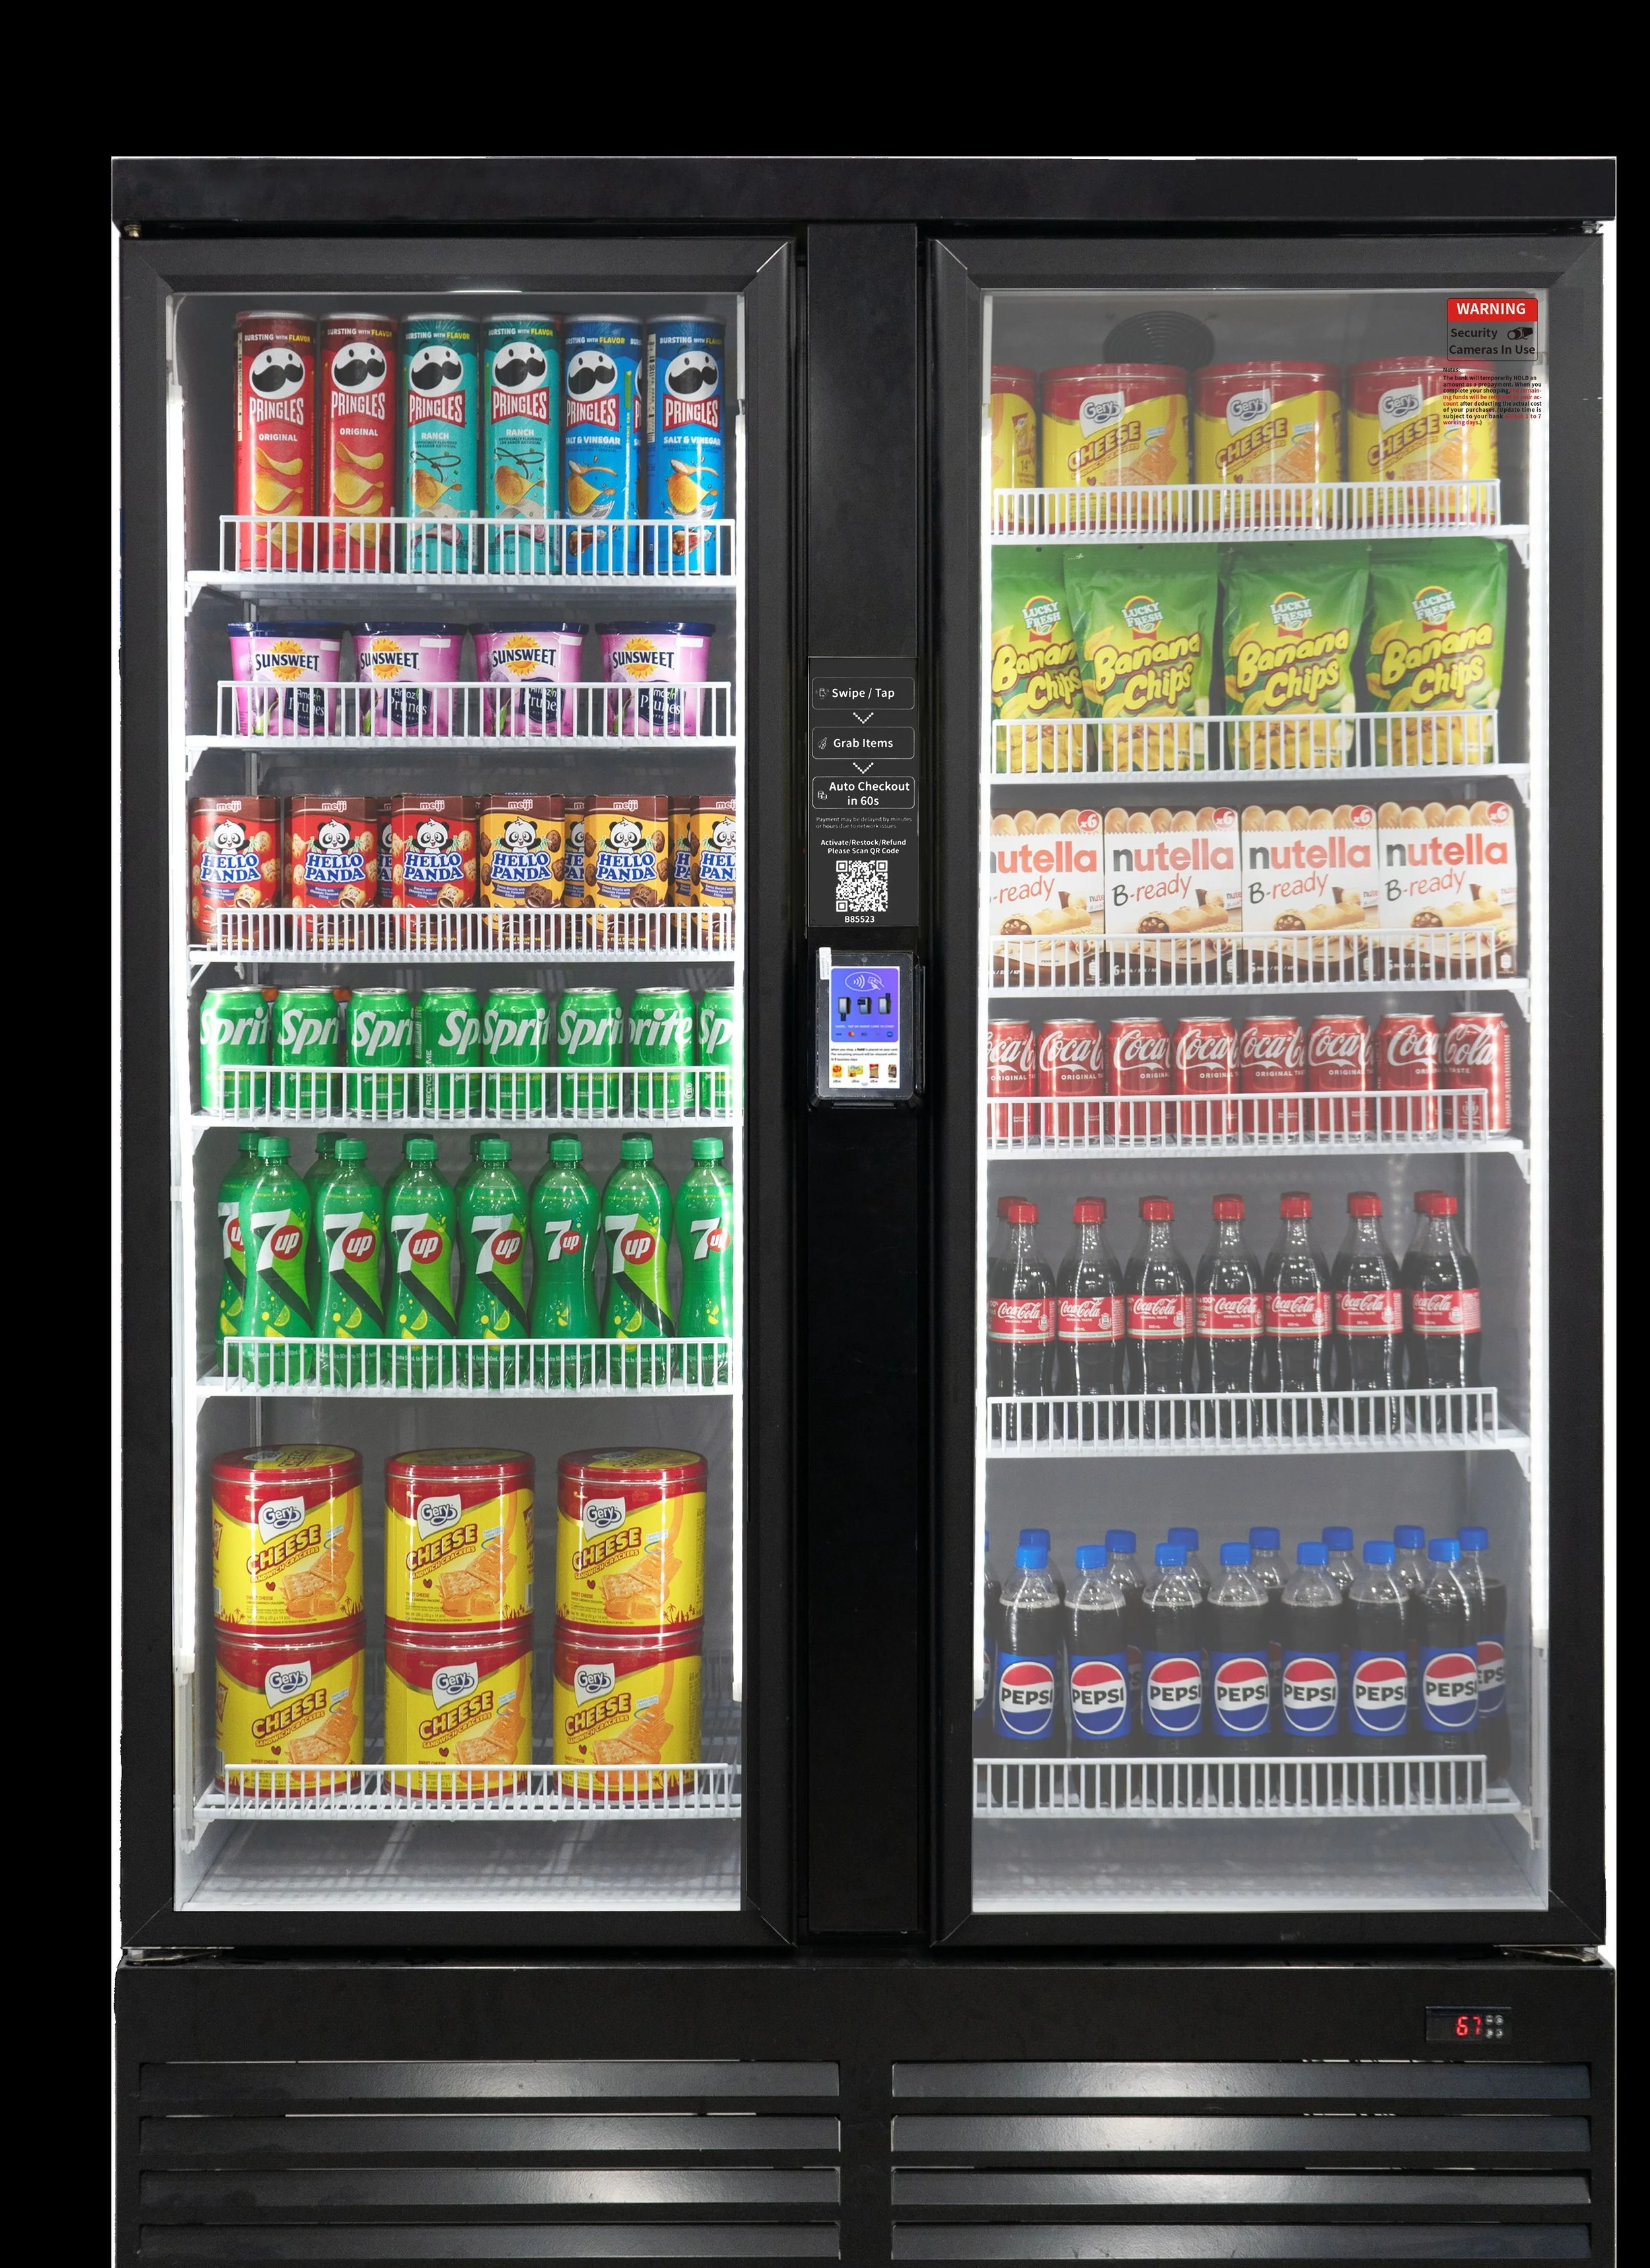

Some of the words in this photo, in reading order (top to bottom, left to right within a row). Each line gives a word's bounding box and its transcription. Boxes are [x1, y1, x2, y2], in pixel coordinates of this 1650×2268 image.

[1457, 303, 1526, 315] WARNING
[288, 335, 311, 343] FLAVOR
[1451, 328, 1498, 339] Security
[1449, 345, 1498, 354] Cameras
[1502, 345, 1512, 354] In
[1515, 345, 1535, 354] Use
[249, 397, 304, 426] PRINGLES
[409, 394, 462, 423] PRINGLES
[493, 391, 547, 420] PRINGLES
[665, 399, 717, 427] PRINGLES
[1084, 401, 1121, 424] Gery
[1382, 395, 1418, 416] Gery
[691, 436, 721, 445] VINEGAR
[1068, 421, 1140, 470] CHEESE
[1368, 414, 1439, 466] CHEESE
[1412, 591, 1452, 609] LUCKY
[1121, 602, 1160, 620] LUCKY
[1415, 601, 1456, 620] FRESH
[1125, 612, 1164, 629] FRESH
[255, 653, 320, 671] SUNSWEET
[492, 649, 556, 667] SUNSWEET
[612, 651, 675, 668] SUNSWEET
[1094, 633, 1201, 692] Banana
[1382, 624, 1493, 686] Banana
[1123, 662, 1193, 711] Chips
[1410, 655, 1484, 706] Chips
[832, 688, 865, 699] Swipe
[868, 688, 872, 699] /
[875, 688, 894, 699] Tap
[640, 694, 680, 715] Punes
[834, 738, 859, 748] Grab
[863, 738, 893, 748] Items
[829, 782, 855, 791] Auto
[858, 782, 909, 791] Checkout
[217, 800, 242, 812] meiji
[508, 799, 533, 811] meiji
[613, 800, 638, 812] meiji
[847, 796, 857, 805] in
[861, 796, 879, 805] 60s
[1216, 812, 1233, 826] x6
[1490, 806, 1507, 820] x6
[1113, 838, 1233, 872] nutella
[1386, 833, 1507, 866] nutella
[202, 854, 257, 868] HELLO
[493, 853, 550, 867] HELLO
[599, 853, 655, 867] HELLO
[201, 867, 260, 881] PANDA
[492, 865, 551, 880] PANDA
[597, 865, 657, 880] PANDA
[1111, 873, 1192, 906] B-ready
[1385, 868, 1466, 901] B-ready
[558, 1007, 622, 1054] Sprit
[587, 1505, 622, 1525] Gery
[247, 1524, 321, 1575] CHEESE
[572, 1528, 641, 1571] CHEESE
[575, 1563, 604, 1580] SANDWICH
[605, 1549, 639, 1567] CRACKERS
[269, 1671, 308, 1693] Gery
[578, 1671, 610, 1693] Gery
[1426, 1681, 1477, 1697] PEPSI
[1001, 1687, 1053, 1705] PEPSI
[1150, 1685, 1201, 1701] PEPSI
[252, 1689, 327, 1740] CHEESE
[565, 1693, 631, 1736] CHEESE
[255, 1727, 290, 1747] SANDWICH
[291, 1711, 325, 1732] CRACKERS
[567, 1730, 595, 1745] SANDWICH
[596, 1715, 629, 1733] CRACKERS
[1456, 2015, 1482, 2036] 67
